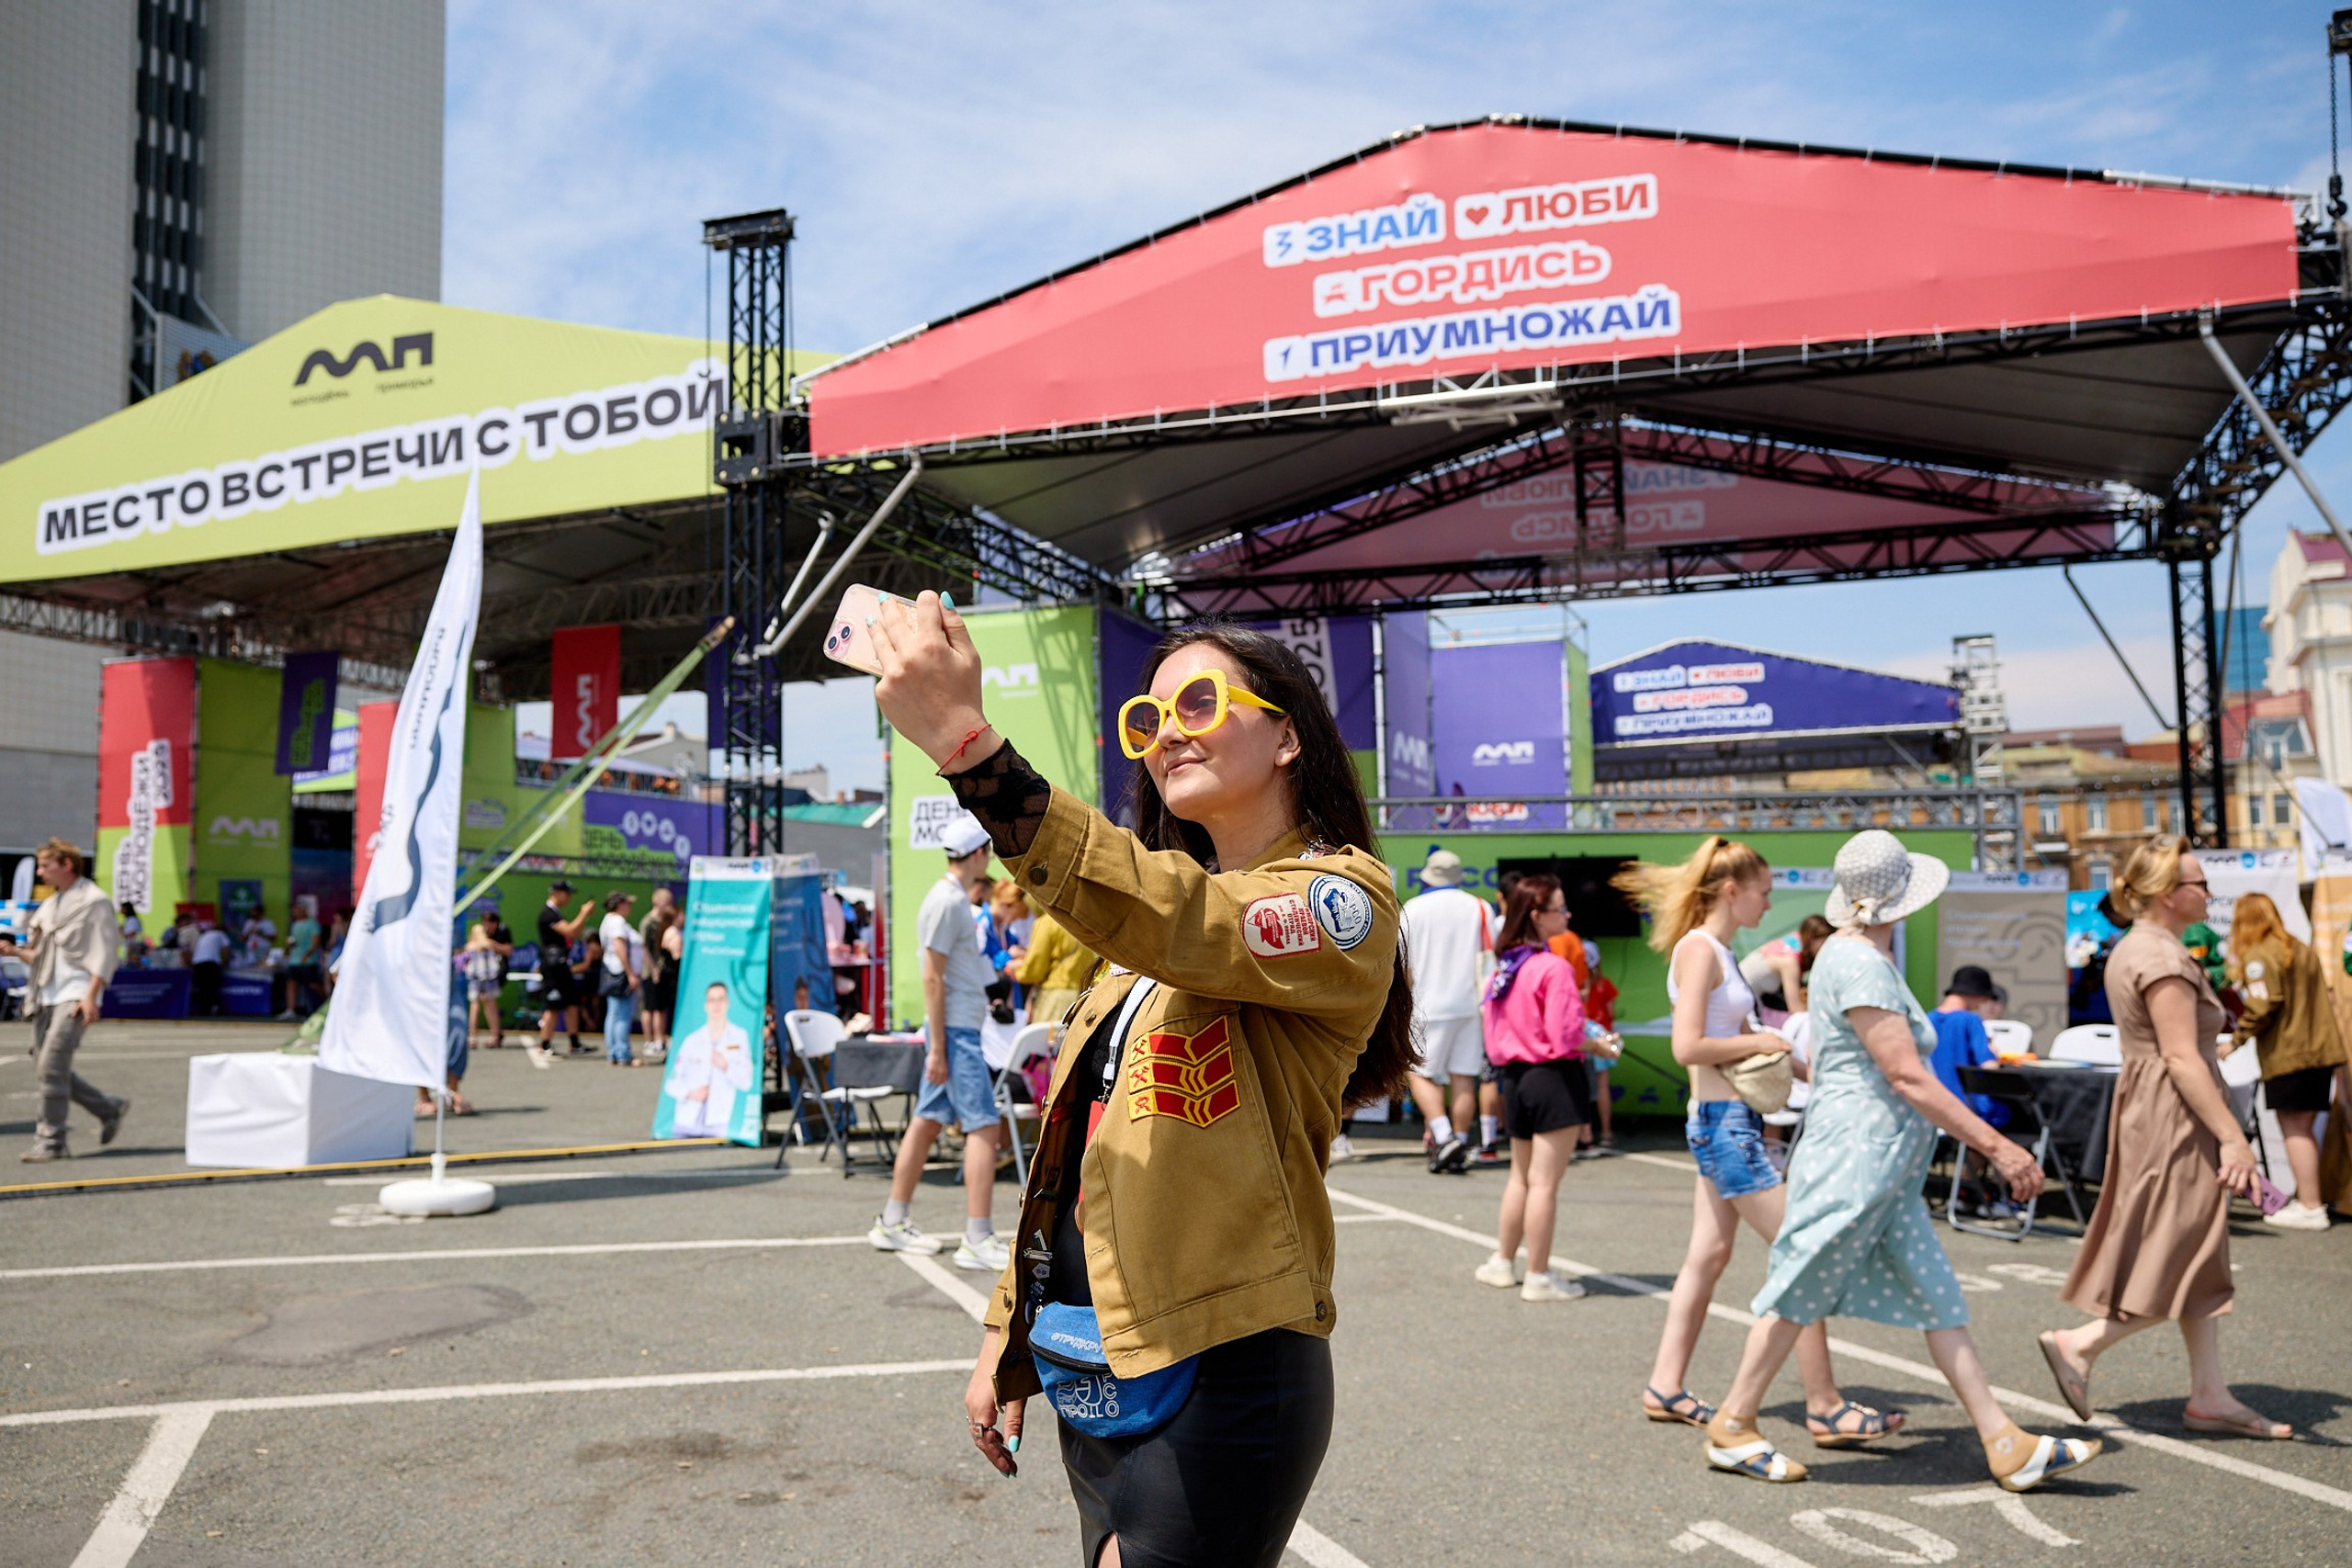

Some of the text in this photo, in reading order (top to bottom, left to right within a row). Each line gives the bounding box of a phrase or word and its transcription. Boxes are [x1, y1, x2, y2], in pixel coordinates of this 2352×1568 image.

[1306, 183, 1649, 253] ЗНАЙ ЛЮБИ
[1360, 249, 1602, 302] ГОРДИСЬ
[1311, 293, 1671, 367] ПРИУМНОЖАЙ
[44, 369, 724, 543] МЕСТО ВСТРЕЧИ С ТОБОЙ
[1287, 913, 1295, 933] ОТРЯД
[1289, 899, 1304, 946] СТУДЕНЧЕСКИЙ
[1298, 908, 1309, 935] КРАЕВОЙ
[1050, 1332, 1104, 1355] #ТРУДКРУ
